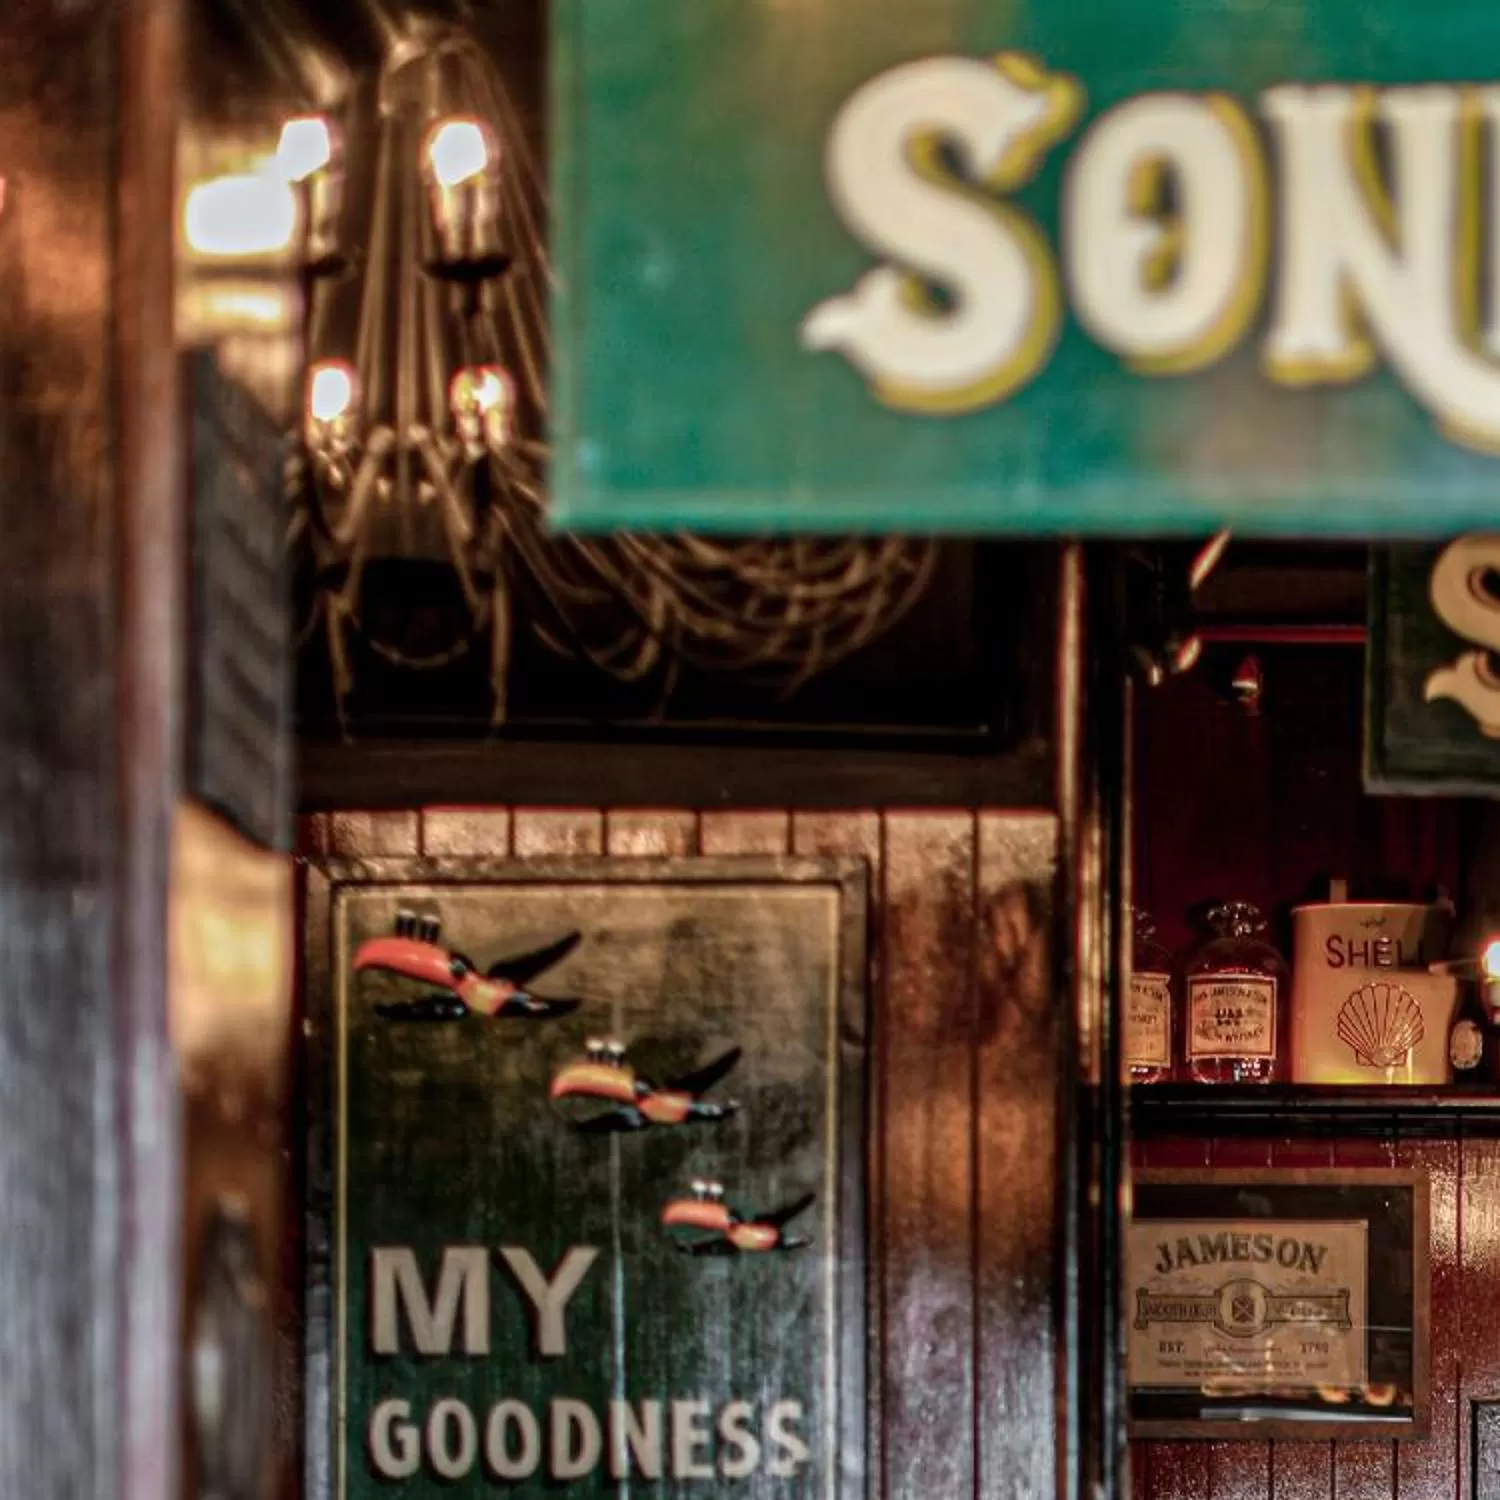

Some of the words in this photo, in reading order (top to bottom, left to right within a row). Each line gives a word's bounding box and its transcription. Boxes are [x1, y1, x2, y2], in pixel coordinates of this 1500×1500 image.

[1155, 1231, 1329, 1276] JAMESON
[366, 1244, 598, 1358] MY
[368, 1397, 811, 1482] GOODNESS
